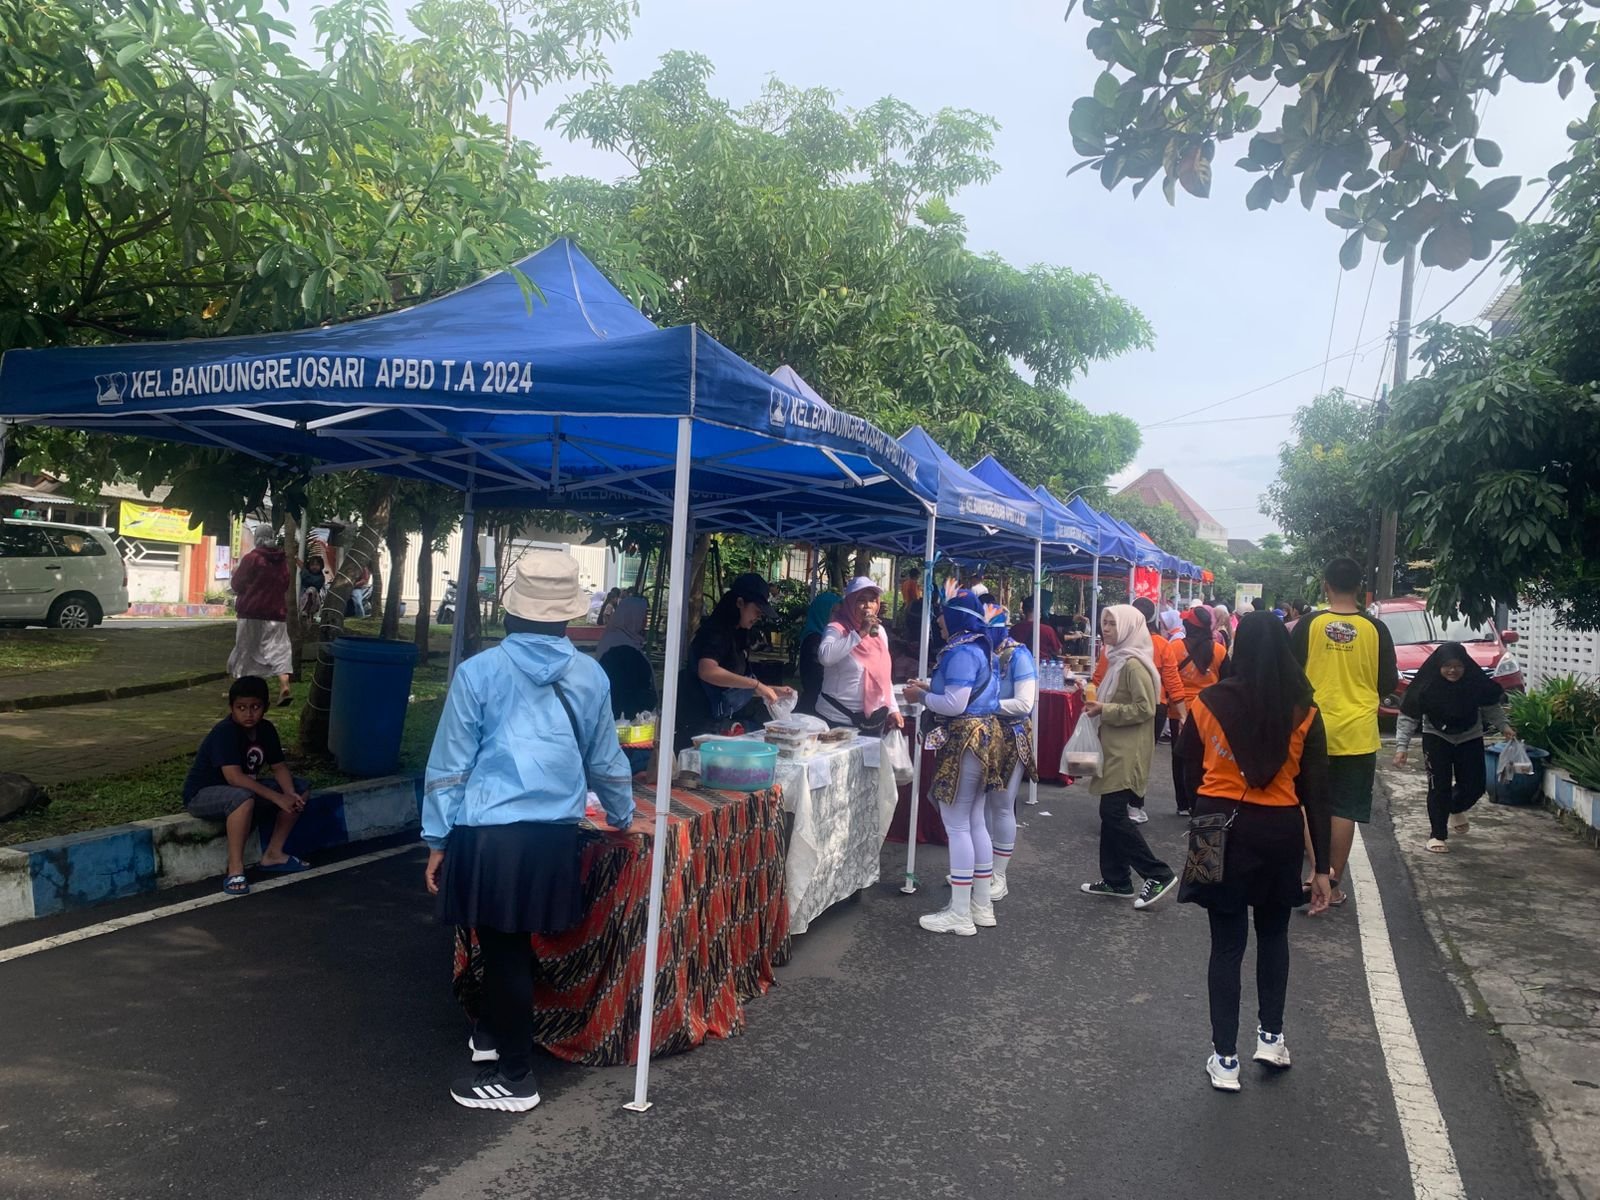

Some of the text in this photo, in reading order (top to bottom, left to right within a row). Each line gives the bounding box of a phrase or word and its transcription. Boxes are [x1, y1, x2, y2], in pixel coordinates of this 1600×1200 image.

[130, 357, 533, 399] KEL.BANDUNGREJOSARI APBD T.A 2024
